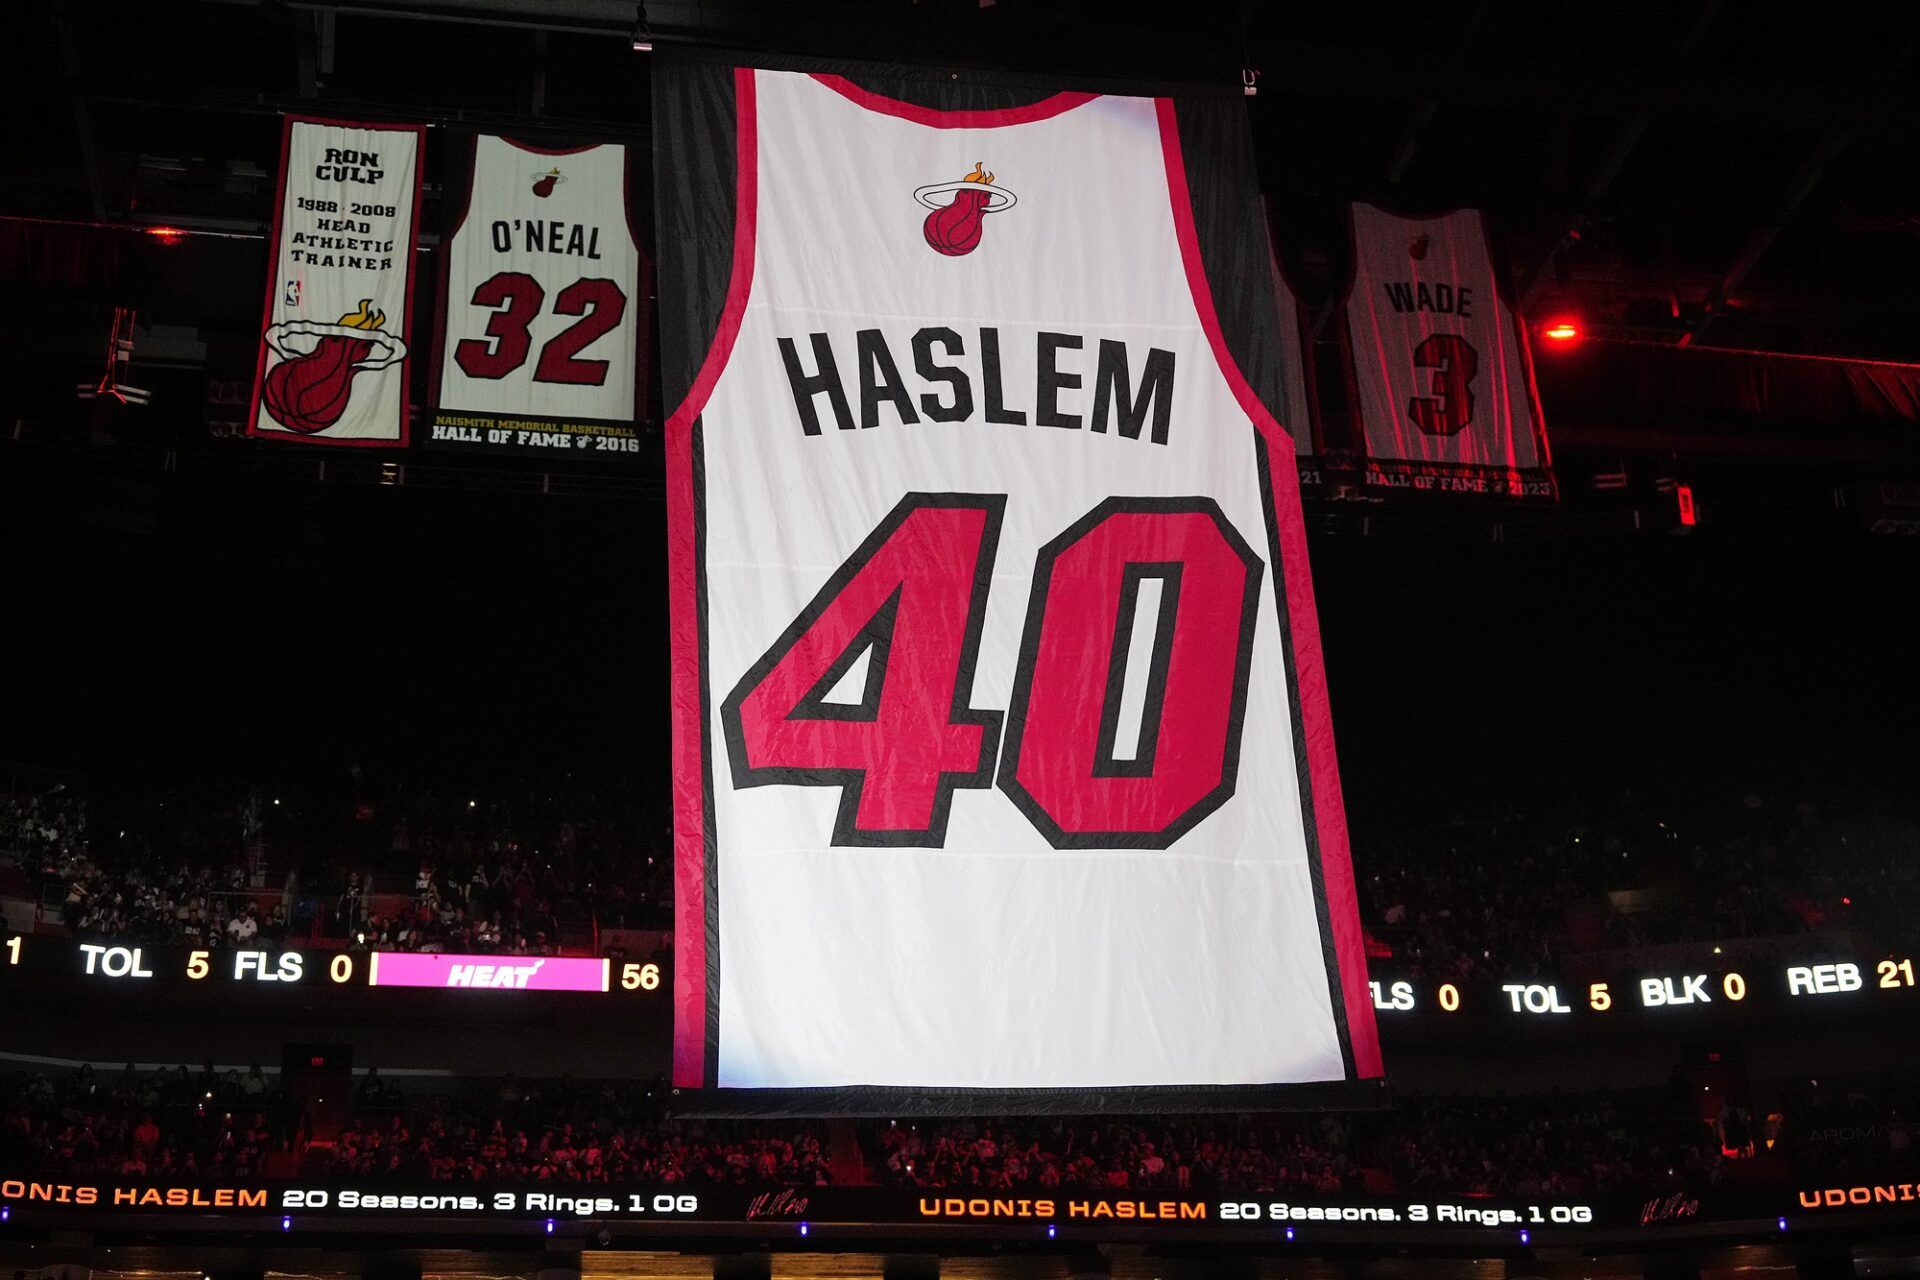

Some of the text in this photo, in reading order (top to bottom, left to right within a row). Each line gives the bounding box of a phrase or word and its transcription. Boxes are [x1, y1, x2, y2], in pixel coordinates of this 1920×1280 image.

[324, 148, 379, 168] RON
[315, 165, 384, 185] CULP
[297, 197, 395, 217] 1988 2008
[317, 218, 370, 233] HEAD
[492, 219, 602, 260] O'NEAL
[292, 232, 393, 253] ATHLETIC
[291, 249, 392, 270] TRAINER
[1385, 283, 1473, 318] WADE
[453, 271, 628, 387] 32
[777, 326, 1176, 446] HASLEM
[1408, 333, 1479, 437] 3
[432, 425, 640, 453] HALL OF FAME 2016
[436, 416, 636, 438] NAISMITH MEMORIAL BASKETBALL
[1365, 470, 1411, 488] HALL
[1414, 475, 1437, 490] OF
[1441, 476, 1489, 493] FAME
[1508, 480, 1552, 497] 2023
[720, 491, 1265, 850] 40
[80, 943, 353, 983] TOL 5 FLS 0
[447, 959, 545, 988] HEAT
[621, 963, 660, 990] 56
[1438, 983, 1460, 1012] 0
[1502, 984, 1571, 1014] TOL
[1590, 983, 1612, 1011] 5
[1640, 974, 1712, 1007] BLK
[1723, 973, 1746, 1001] 0
[1787, 963, 1863, 996] REB
[1877, 959, 1915, 989] 21
[114, 1188, 267, 1207] HASLEM
[282, 1190, 329, 1208] 20
[337, 1190, 485, 1210] Seasons.
[493, 1192, 516, 1210] 3
[525, 1193, 620, 1216] Rings.
[628, 1194, 645, 1212] 1
[653, 1194, 698, 1213] OG
[1799, 1184, 1920, 1208] UDONI
[919, 1198, 1593, 1226] UDONIS HASLEM 20 Seasons. 3 Rings. 1 OG
